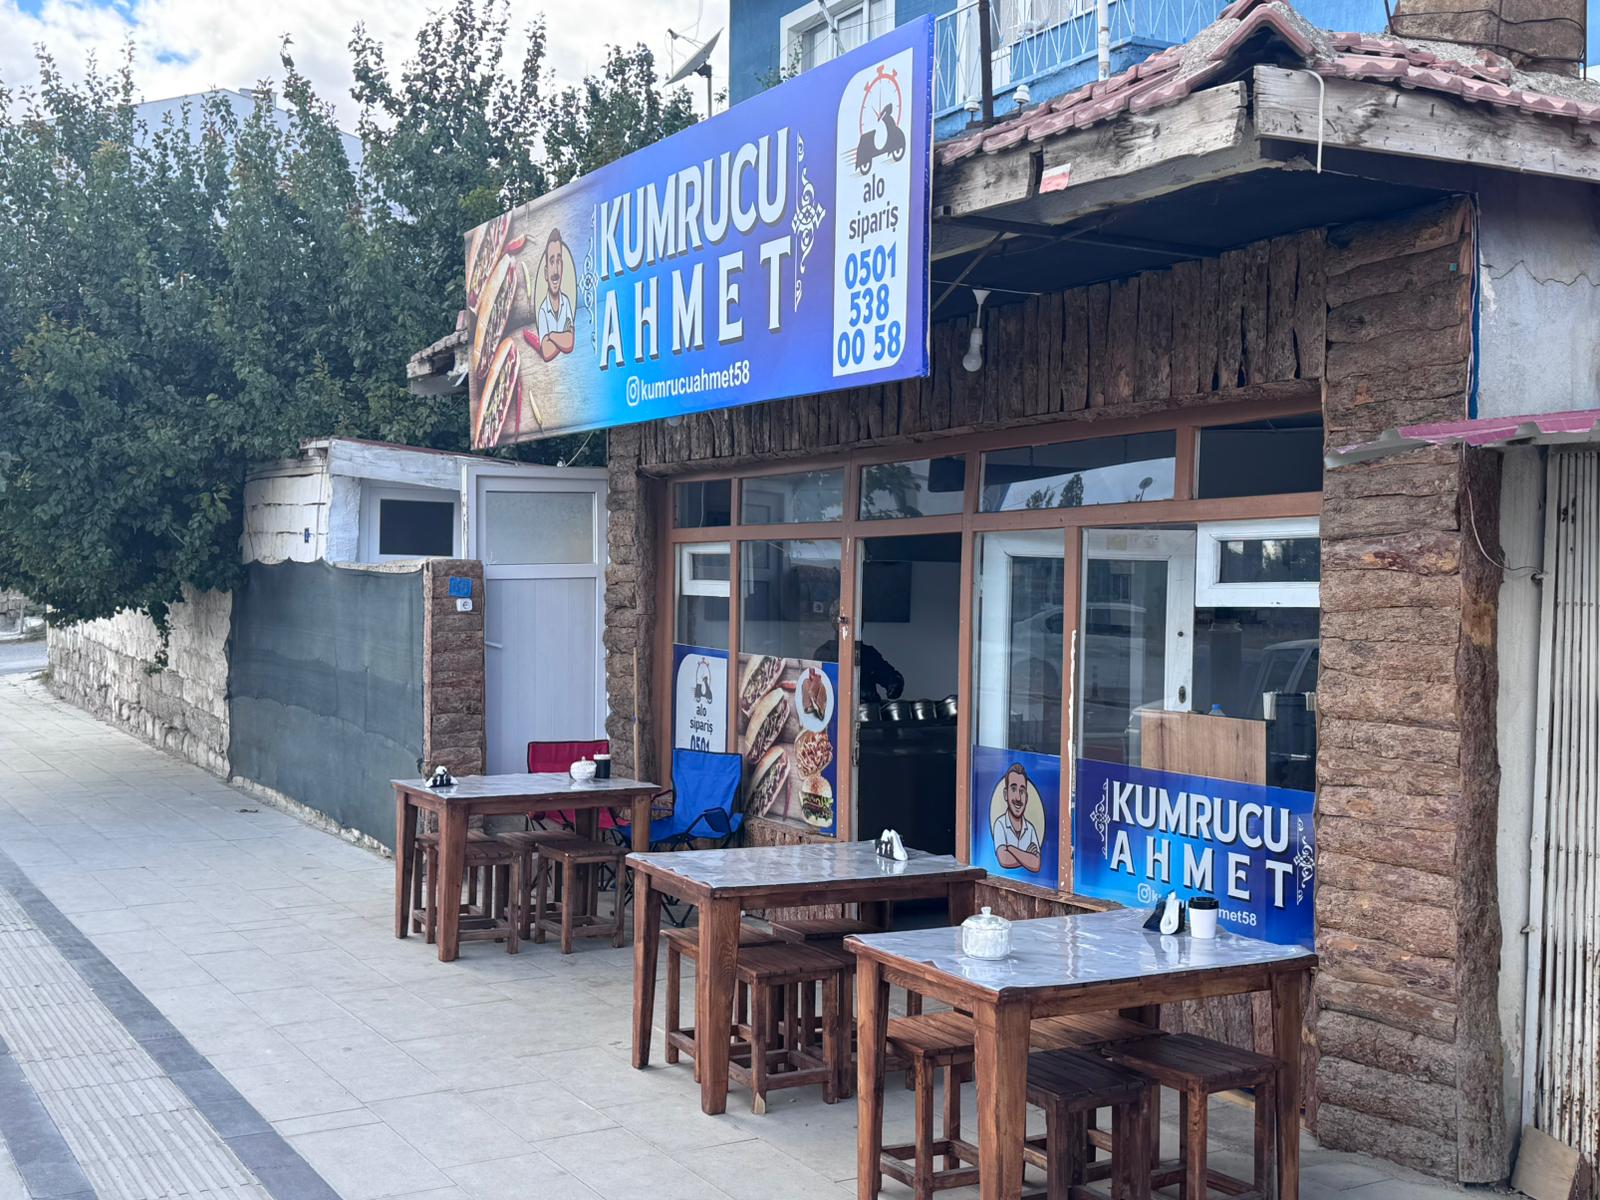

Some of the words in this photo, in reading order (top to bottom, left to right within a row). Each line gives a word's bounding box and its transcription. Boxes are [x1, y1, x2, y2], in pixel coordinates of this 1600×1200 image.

[600, 127, 789, 280] KUMRUCU
[863, 174, 885, 203] alo
[849, 201, 899, 243] sipariş
[844, 241, 897, 289] 0501
[600, 235, 791, 369] AHMET
[849, 283, 890, 327] 538
[837, 331, 866, 367] 00
[873, 320, 901, 361] 58
[641, 359, 750, 401] kumrucuahmet58
[689, 716, 713, 735] sipariş
[696, 703, 707, 716] alo
[1112, 780, 1291, 854] KUMRUCU
[1110, 830, 1294, 909] AHMET
